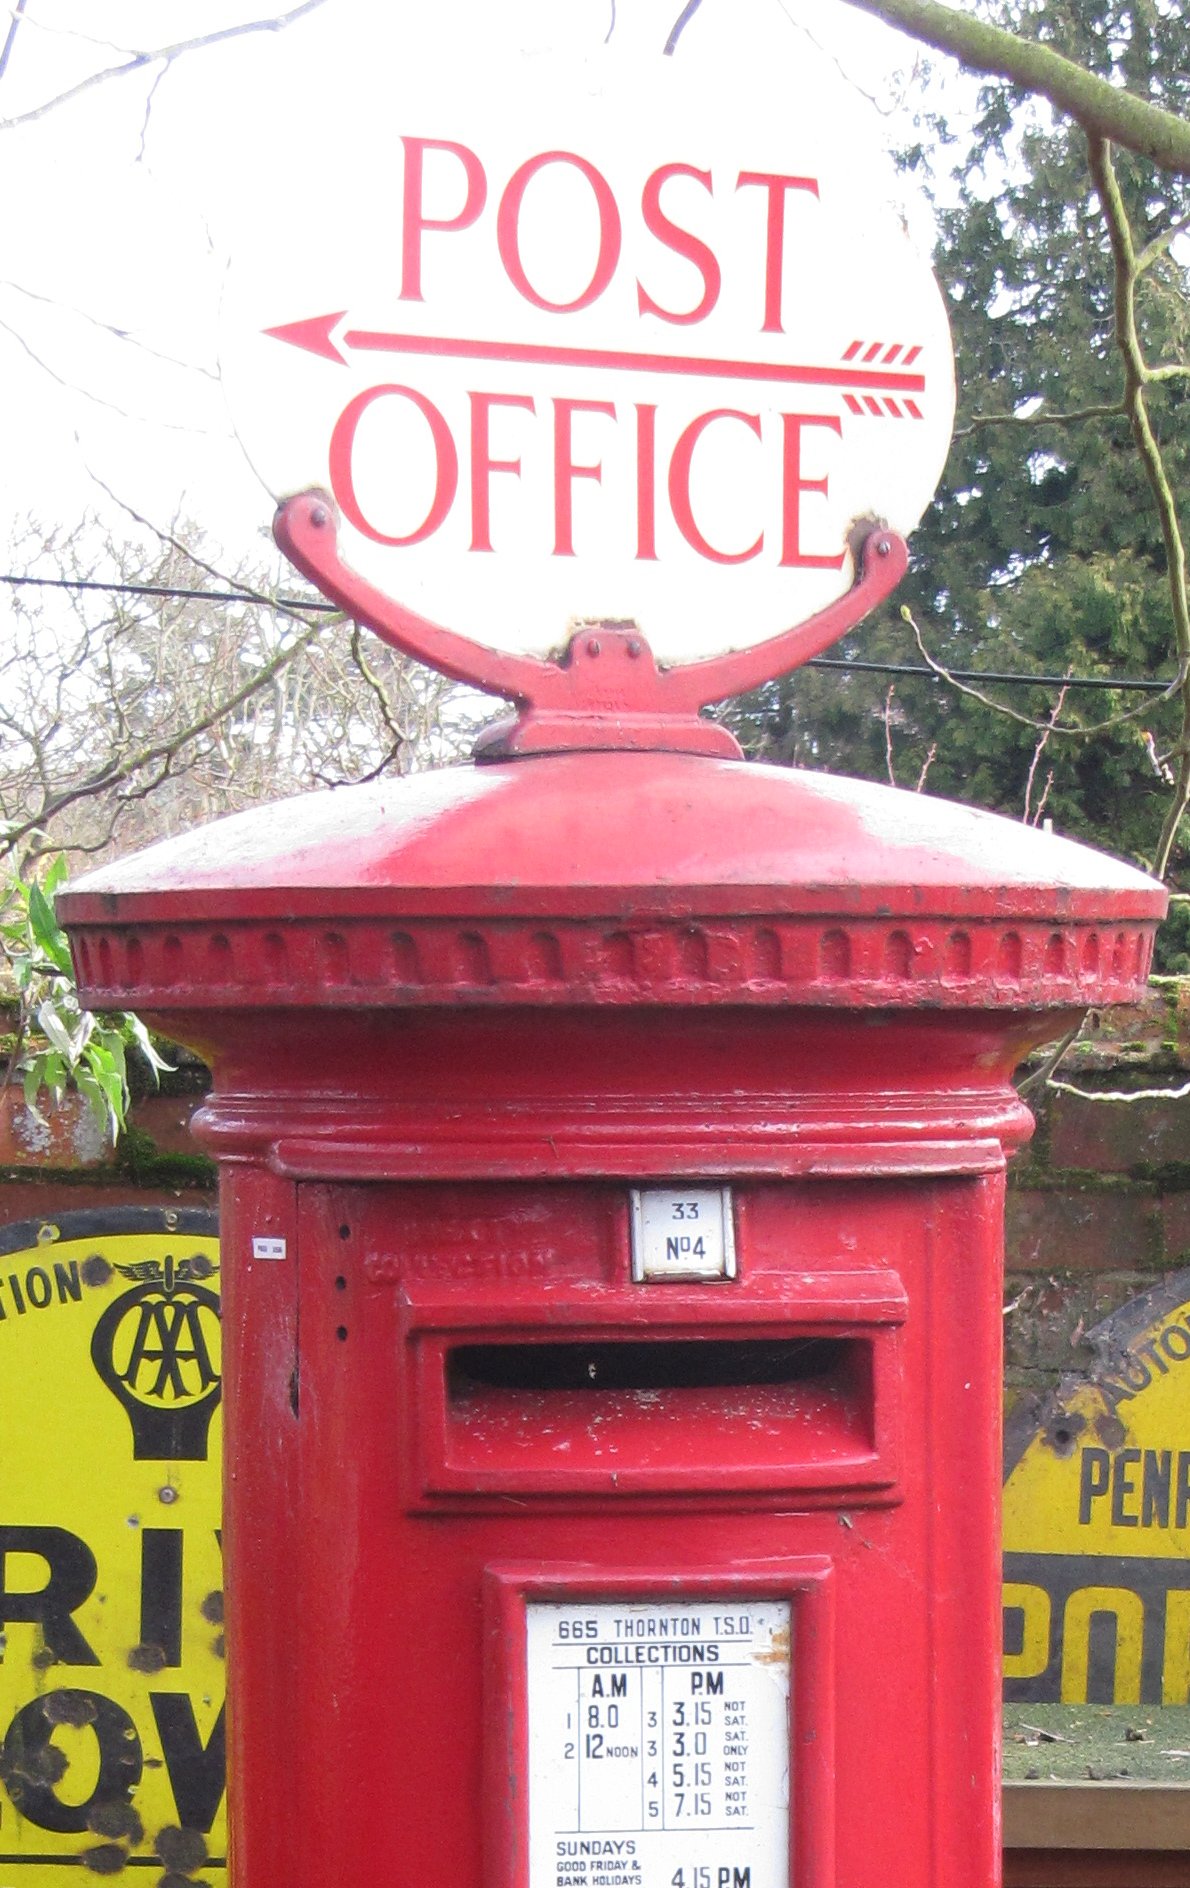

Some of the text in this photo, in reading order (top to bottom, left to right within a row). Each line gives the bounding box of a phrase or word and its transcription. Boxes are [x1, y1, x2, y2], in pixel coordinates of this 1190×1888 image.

[398, 135, 820, 334] POST
[328, 383, 848, 572] OFFICE
[671, 1202, 699, 1220] 33
[1098, 1312, 1190, 1420] AUTO
[0, 1525, 224, 1668] RI
[558, 1620, 599, 1639] 665
[613, 1617, 701, 1638] THORNTON
[586, 1644, 720, 1665] COLLECTIONS
[591, 1673, 627, 1698] A.M
[691, 1671, 724, 1695] P.M
[587, 1704, 619, 1728] 8.0
[647, 1702, 712, 1728] 3 3.15
[724, 1701, 746, 1712] NOT
[724, 1716, 749, 1726] SAT.
[564, 1734, 638, 1759] 2 12 NOON
[647, 1732, 707, 1757] 3 3.0
[723, 1745, 749, 1756] ONLY
[647, 1762, 712, 1788] 4 5.15
[724, 1761, 747, 1772] NOT
[648, 1793, 712, 1818] 5 7.15
[725, 1791, 747, 1801] NOT
[556, 1840, 636, 1857] SUNDAYS
[556, 1860, 641, 1872] GOOD FRIDAY &
[556, 1874, 642, 1887] BANK HOLIDAYS
